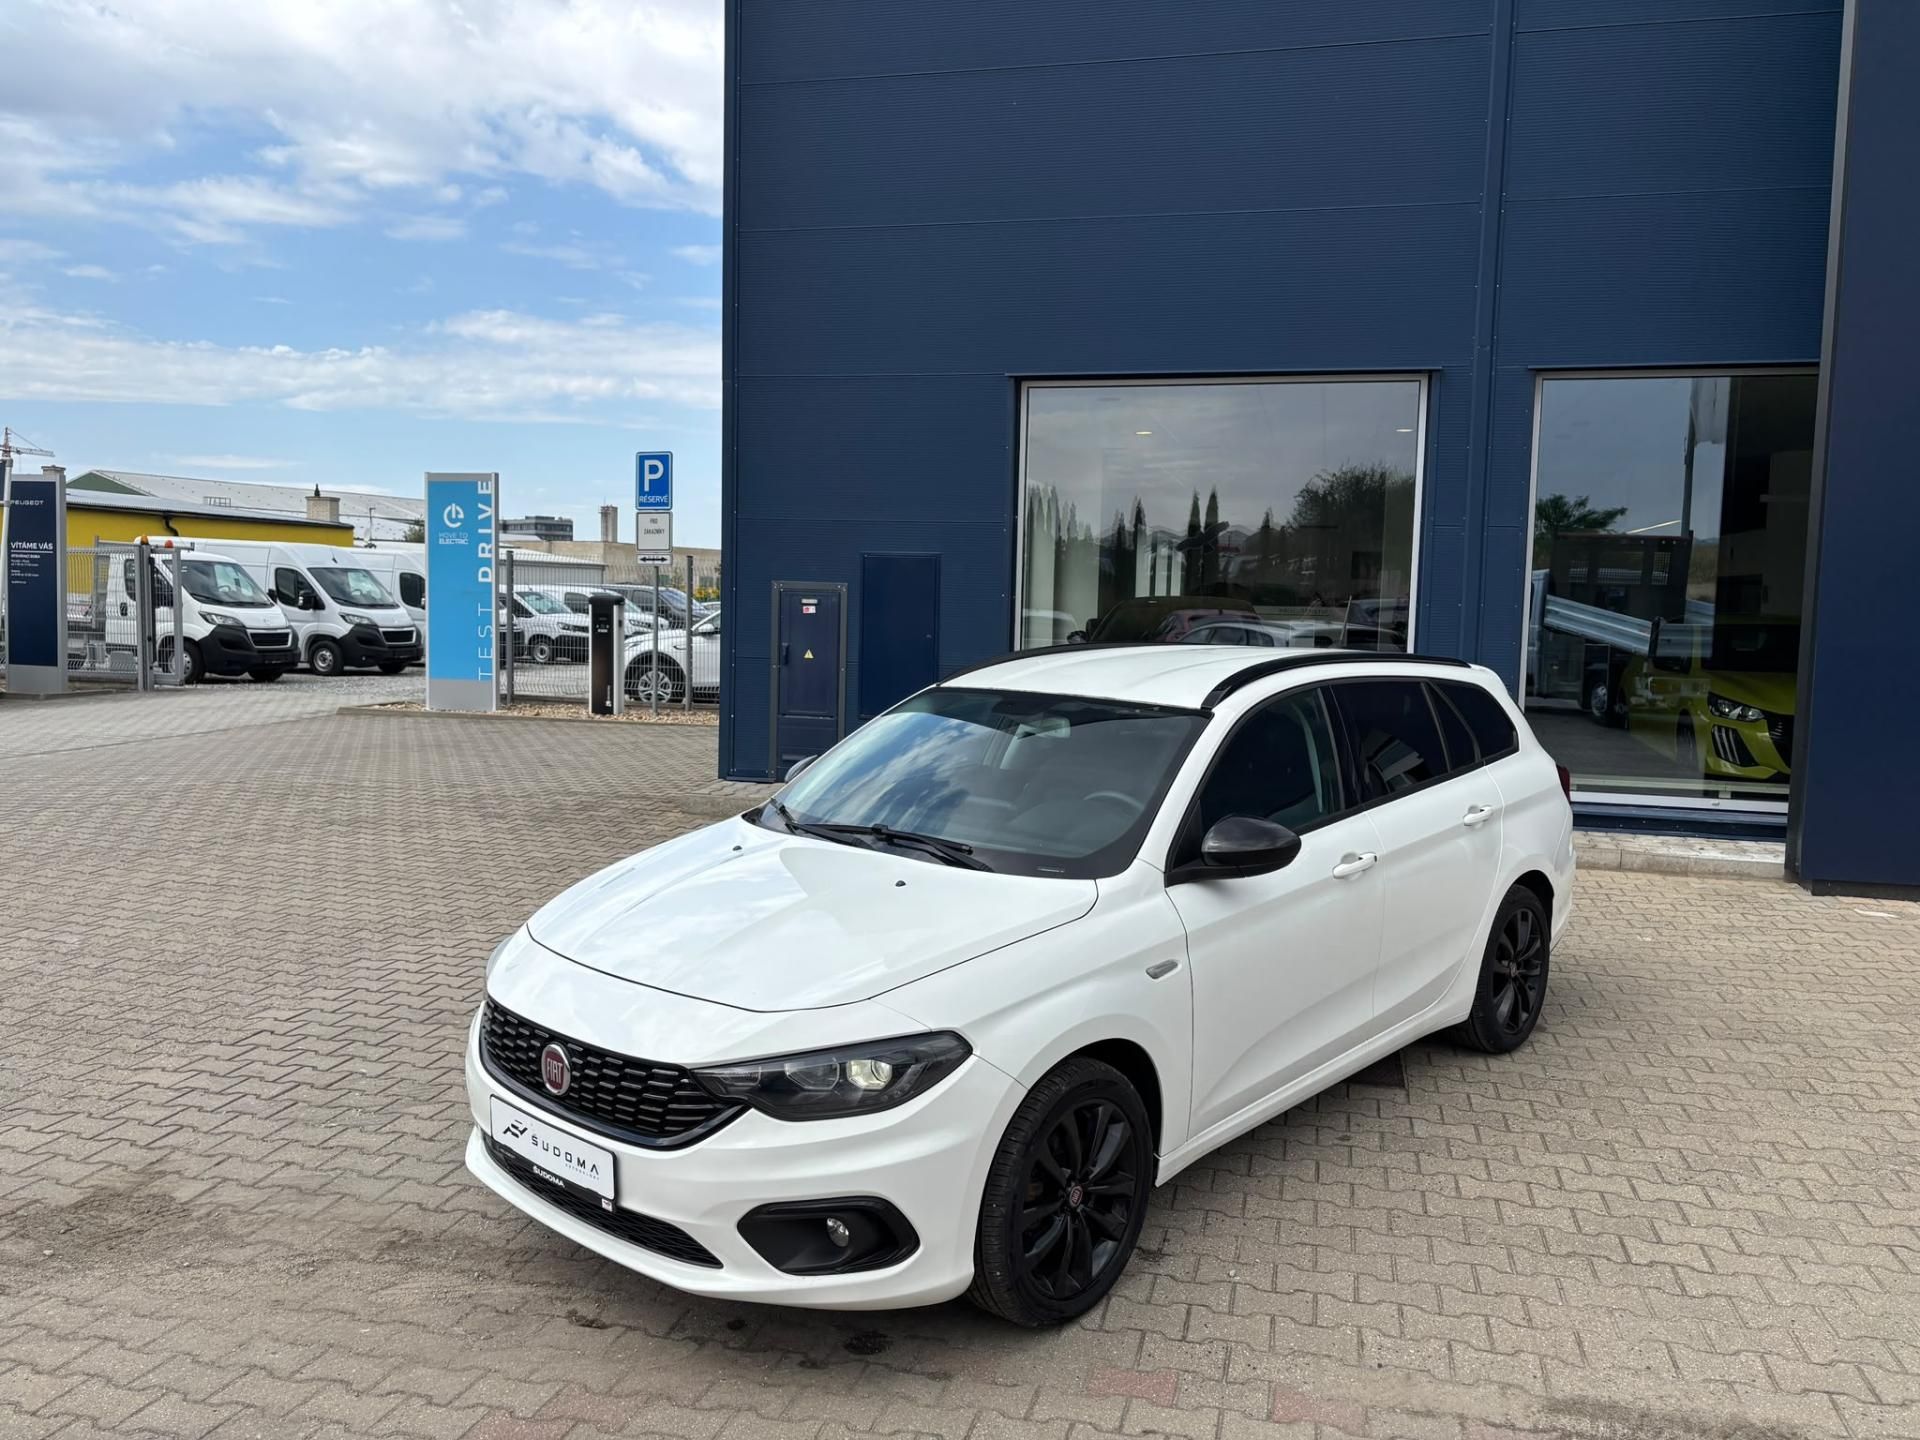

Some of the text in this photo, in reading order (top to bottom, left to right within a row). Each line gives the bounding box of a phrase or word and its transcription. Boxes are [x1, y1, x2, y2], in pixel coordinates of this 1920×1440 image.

[643, 459, 664, 492] P
[11, 541, 53, 550] VÍTÁME VÁS
[478, 480, 493, 681] TEST DRIVE
[547, 1057, 563, 1084] FIAT
